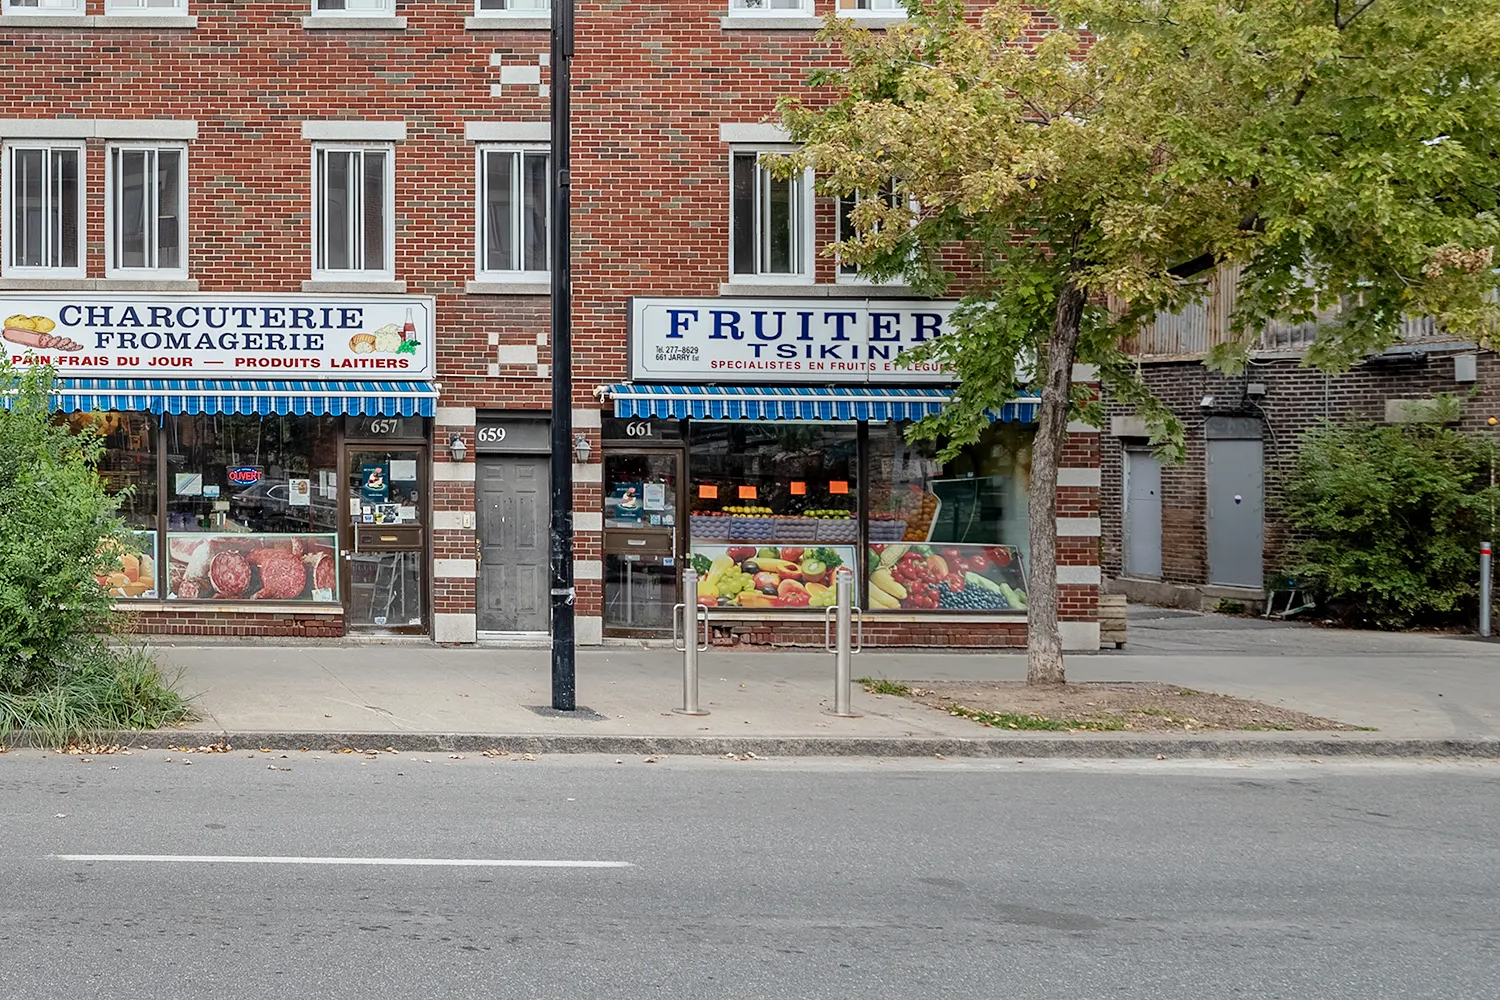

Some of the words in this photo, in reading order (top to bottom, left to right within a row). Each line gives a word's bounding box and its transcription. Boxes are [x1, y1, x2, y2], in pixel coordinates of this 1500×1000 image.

[58, 304, 364, 330] CHARCUTERIE
[94, 331, 325, 351] FROMAGERIE
[666, 345, 699, 354] 277-8629
[668, 353, 690, 361] JARRY
[59, 355, 110, 367] FRAIS
[116, 356, 140, 367] DU
[148, 356, 193, 368] JOUR
[235, 357, 321, 369] PRODUITS
[330, 358, 410, 370] LAITIERS
[710, 360, 801, 370] SPECIALISTES
[808, 361, 824, 370] EN
[830, 361, 877, 371] FRUITS
[370, 419, 398, 434] 657
[626, 421, 653, 437] 661
[478, 427, 506, 442] 659
[229, 470, 263, 481] OUVERT
